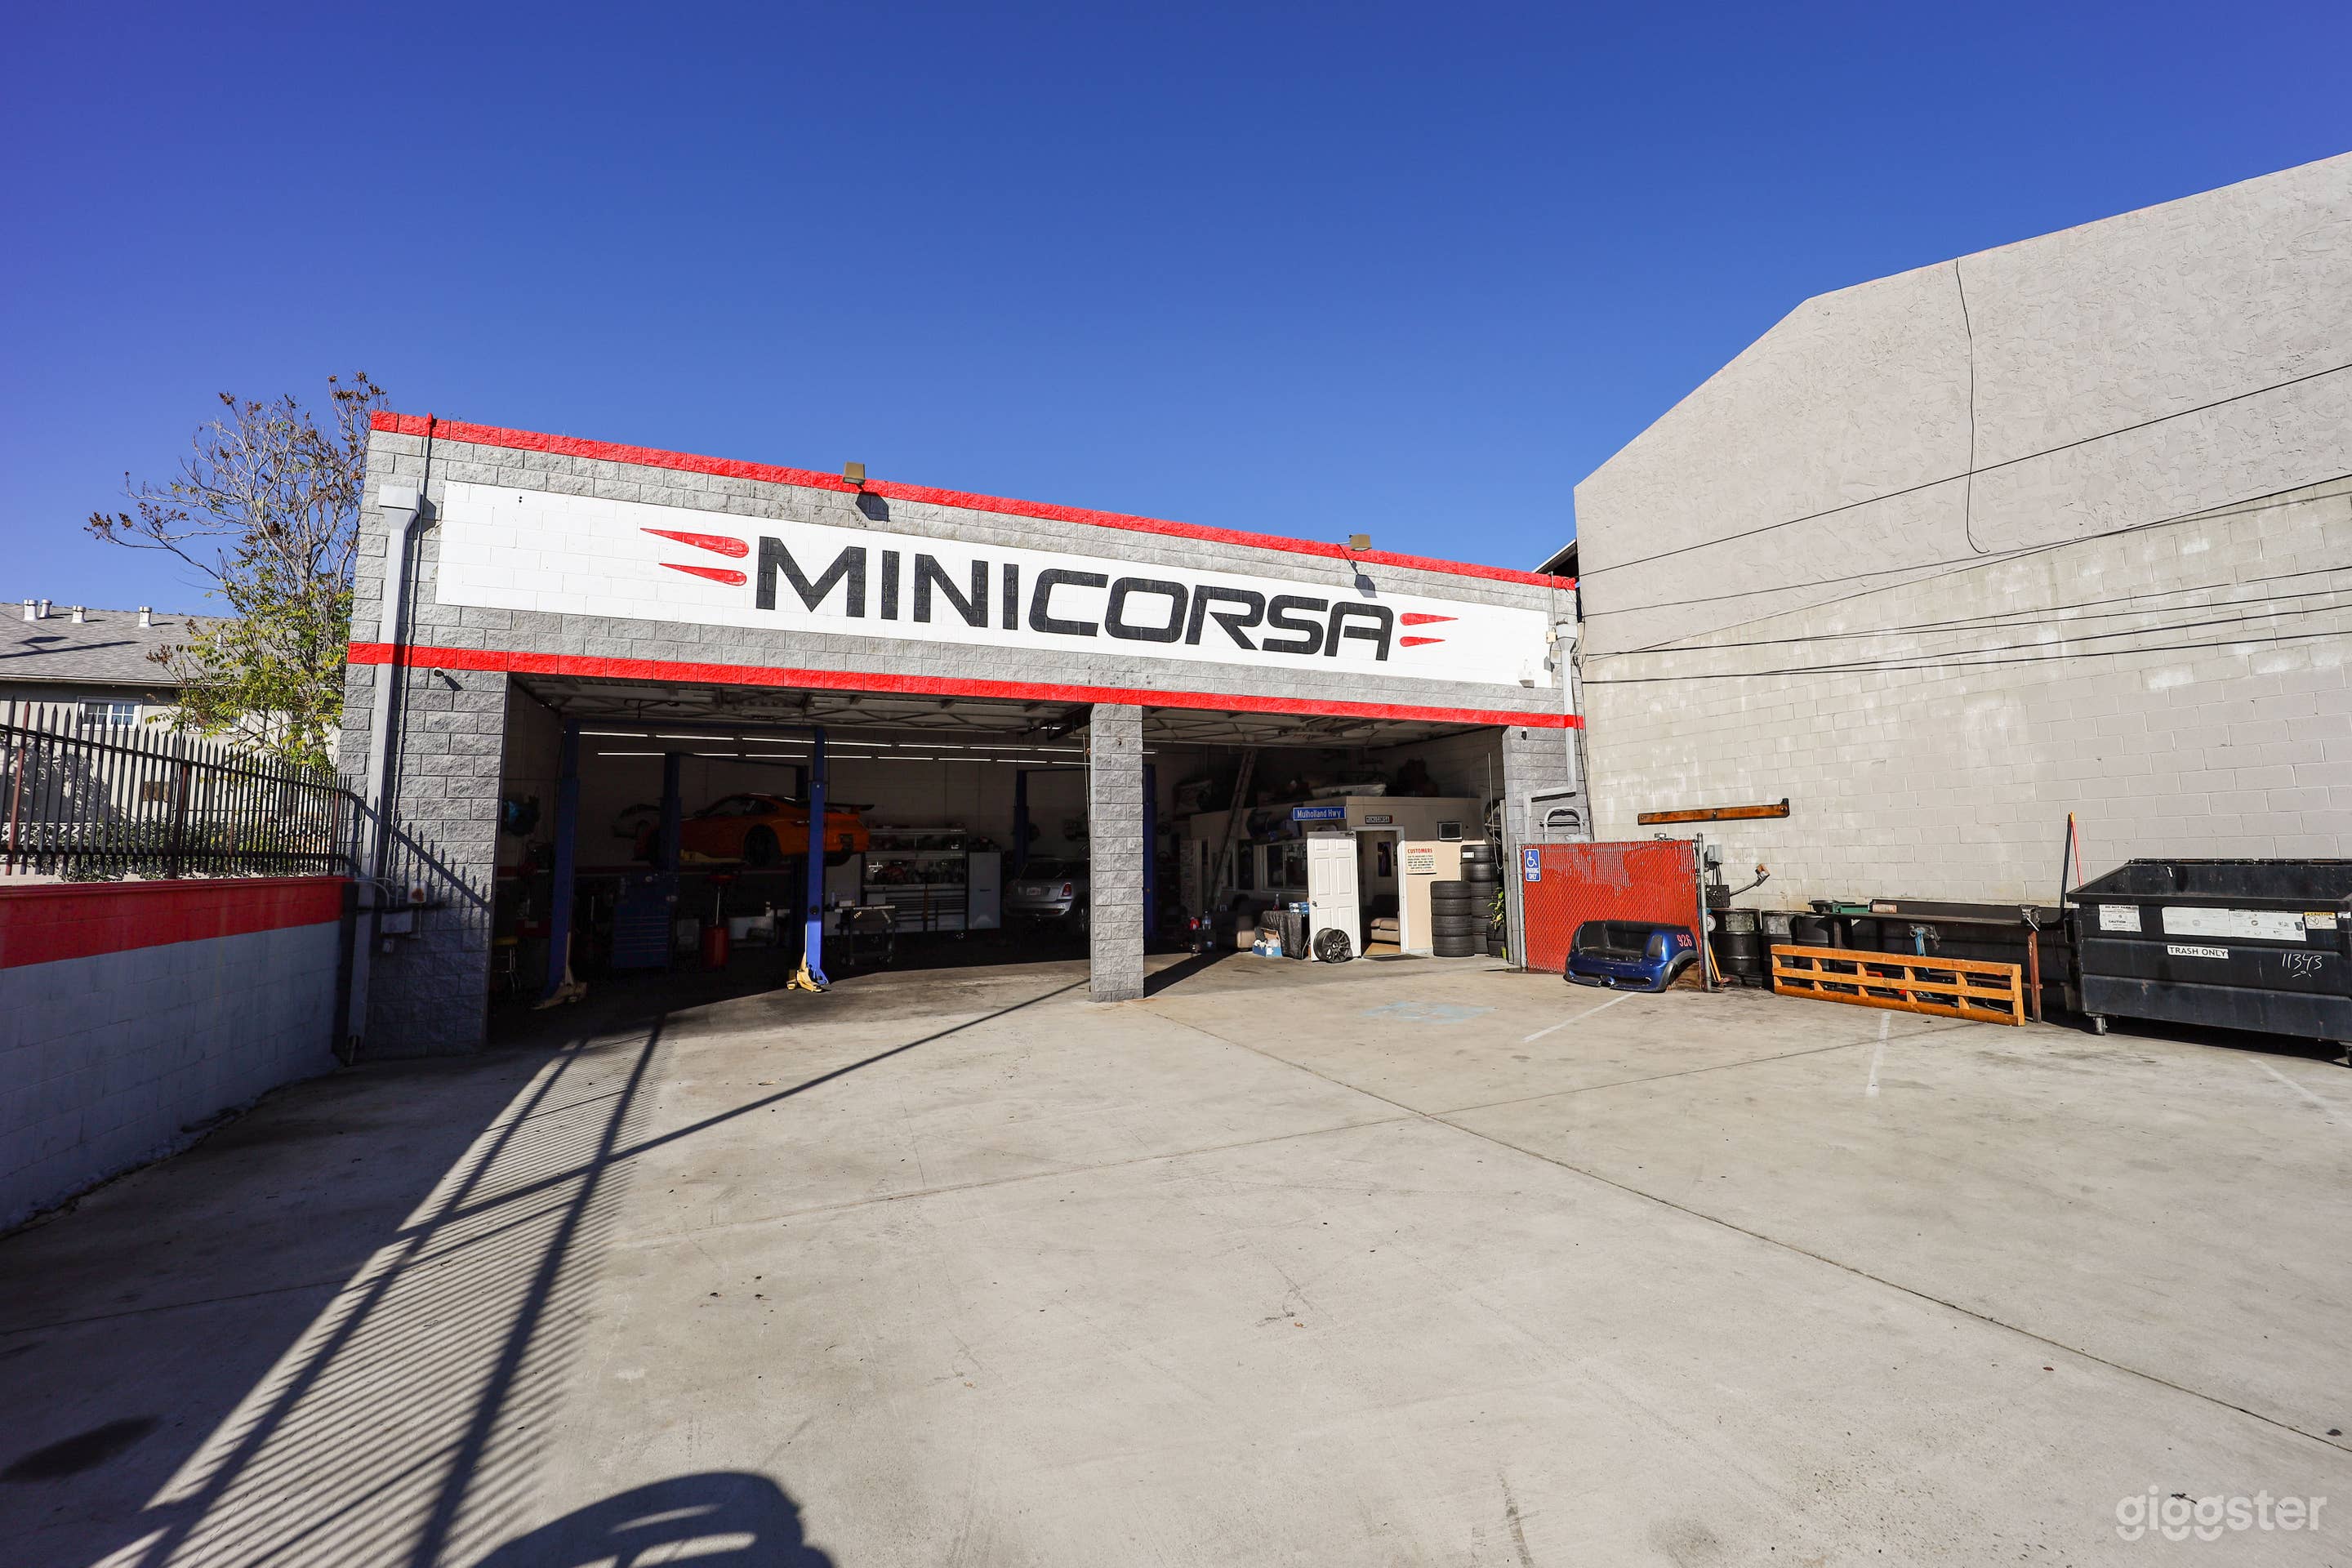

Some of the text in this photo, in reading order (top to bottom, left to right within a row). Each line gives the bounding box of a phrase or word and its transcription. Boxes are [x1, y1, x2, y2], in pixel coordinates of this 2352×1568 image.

[756, 536, 1394, 661] MINICORSA
[1297, 809, 1341, 818] Mulholland Hwy
[1677, 934, 1692, 947] 926
[2169, 947, 2226, 957] TRASH ONLY
[2282, 953, 2323, 971] 11343
